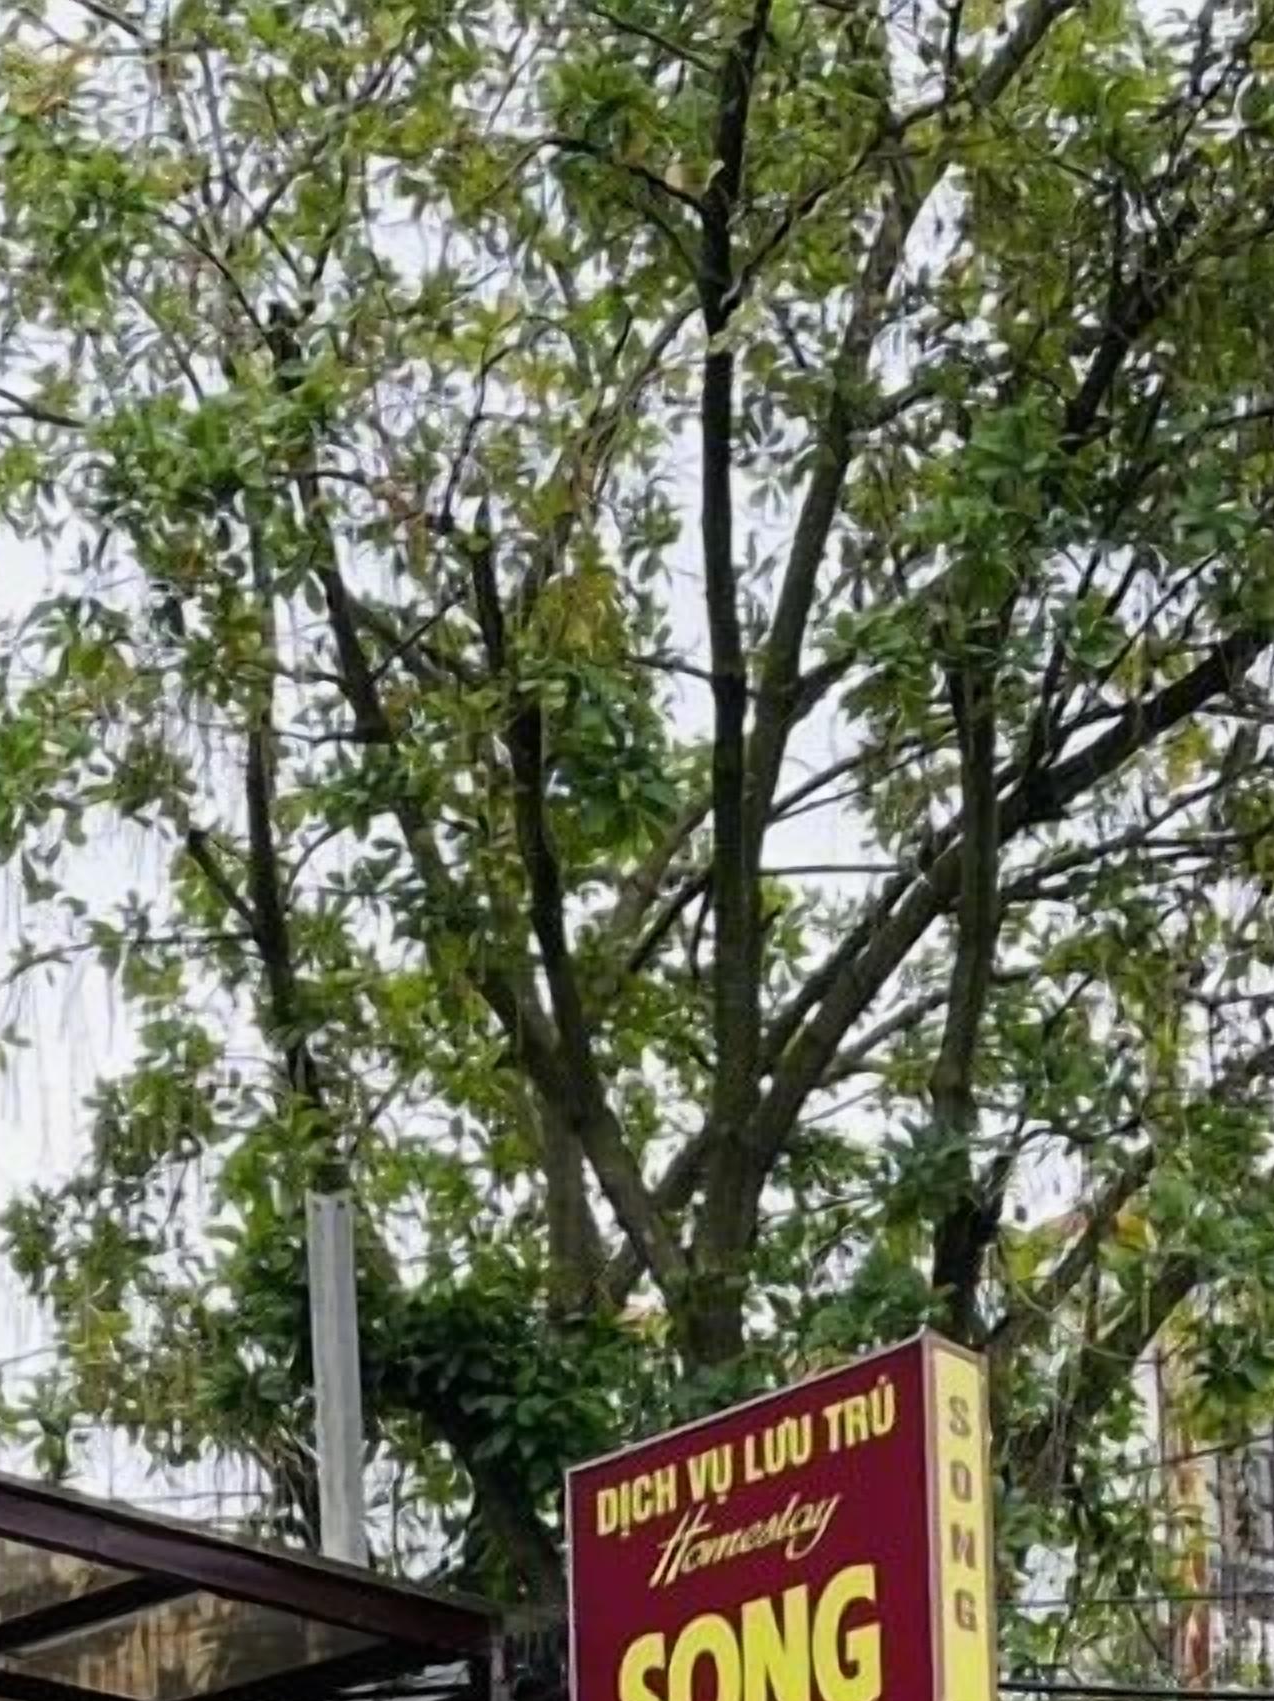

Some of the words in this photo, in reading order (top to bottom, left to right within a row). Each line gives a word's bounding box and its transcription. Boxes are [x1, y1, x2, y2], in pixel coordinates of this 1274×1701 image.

[597, 1463, 677, 1538] DỊCH
[686, 1443, 734, 1504] VỤ
[744, 1413, 812, 1484] LƯU
[948, 1395, 978, 1633] SONG
[649, 1493, 842, 1588] Homestay
